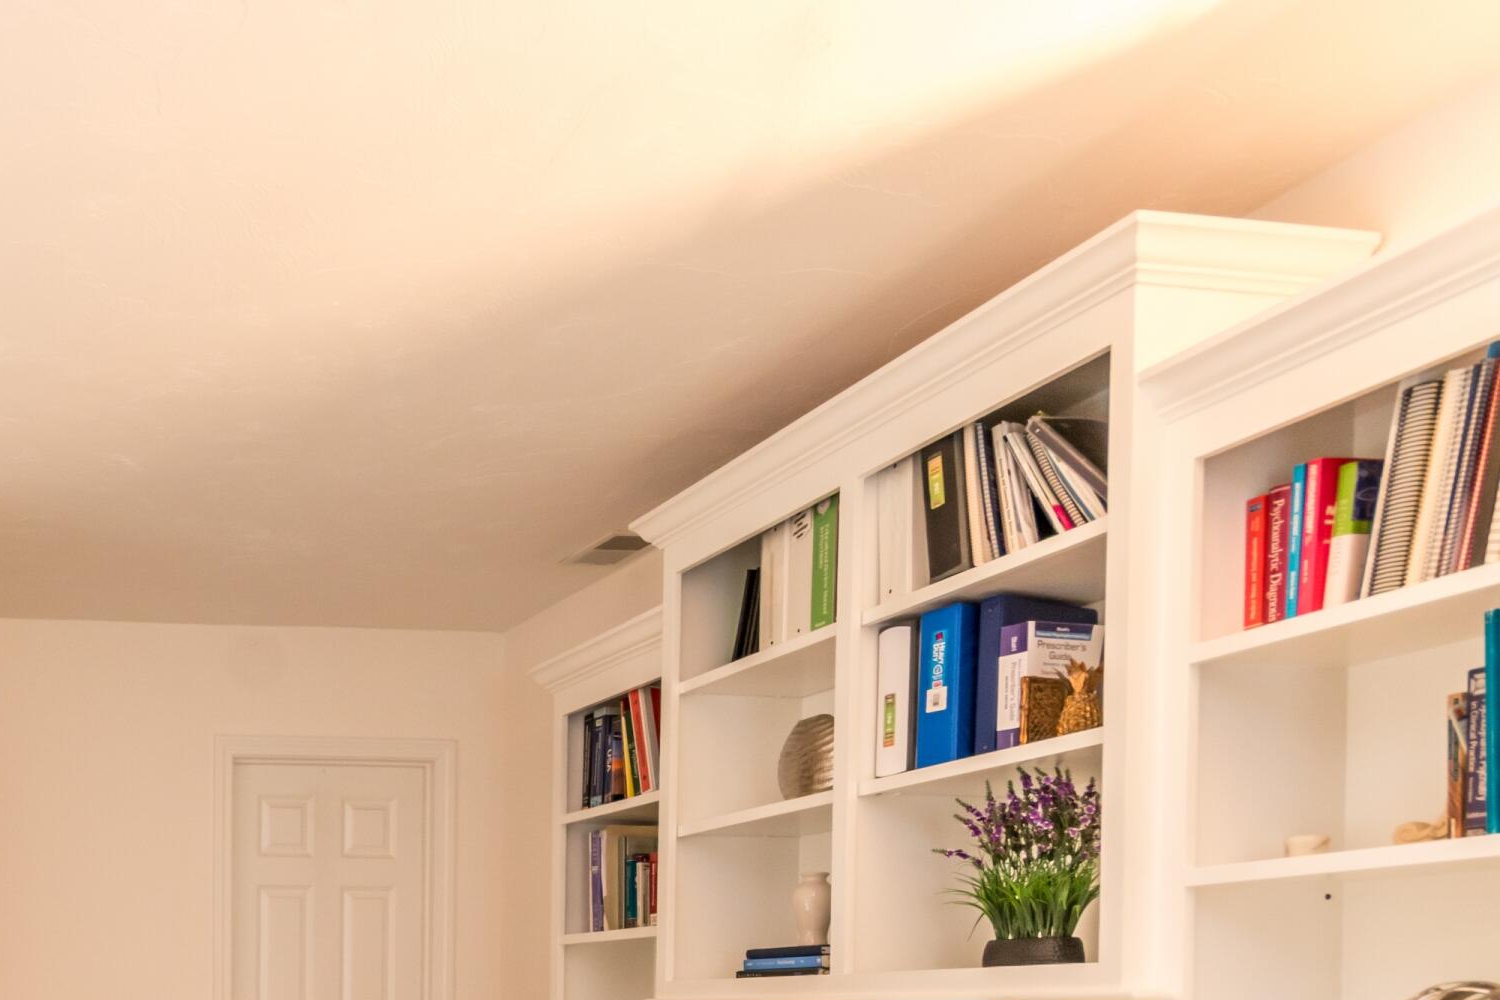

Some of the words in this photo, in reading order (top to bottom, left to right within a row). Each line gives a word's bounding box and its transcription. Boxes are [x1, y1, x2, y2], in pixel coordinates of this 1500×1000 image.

[1267, 498, 1285, 571] Psychoanalytic
[1266, 573, 1283, 622] Diagnosis
[1036, 639, 1087, 652] Prescriber's
[1469, 710, 1479, 739] Clinical
[1467, 740, 1478, 772] Practice
